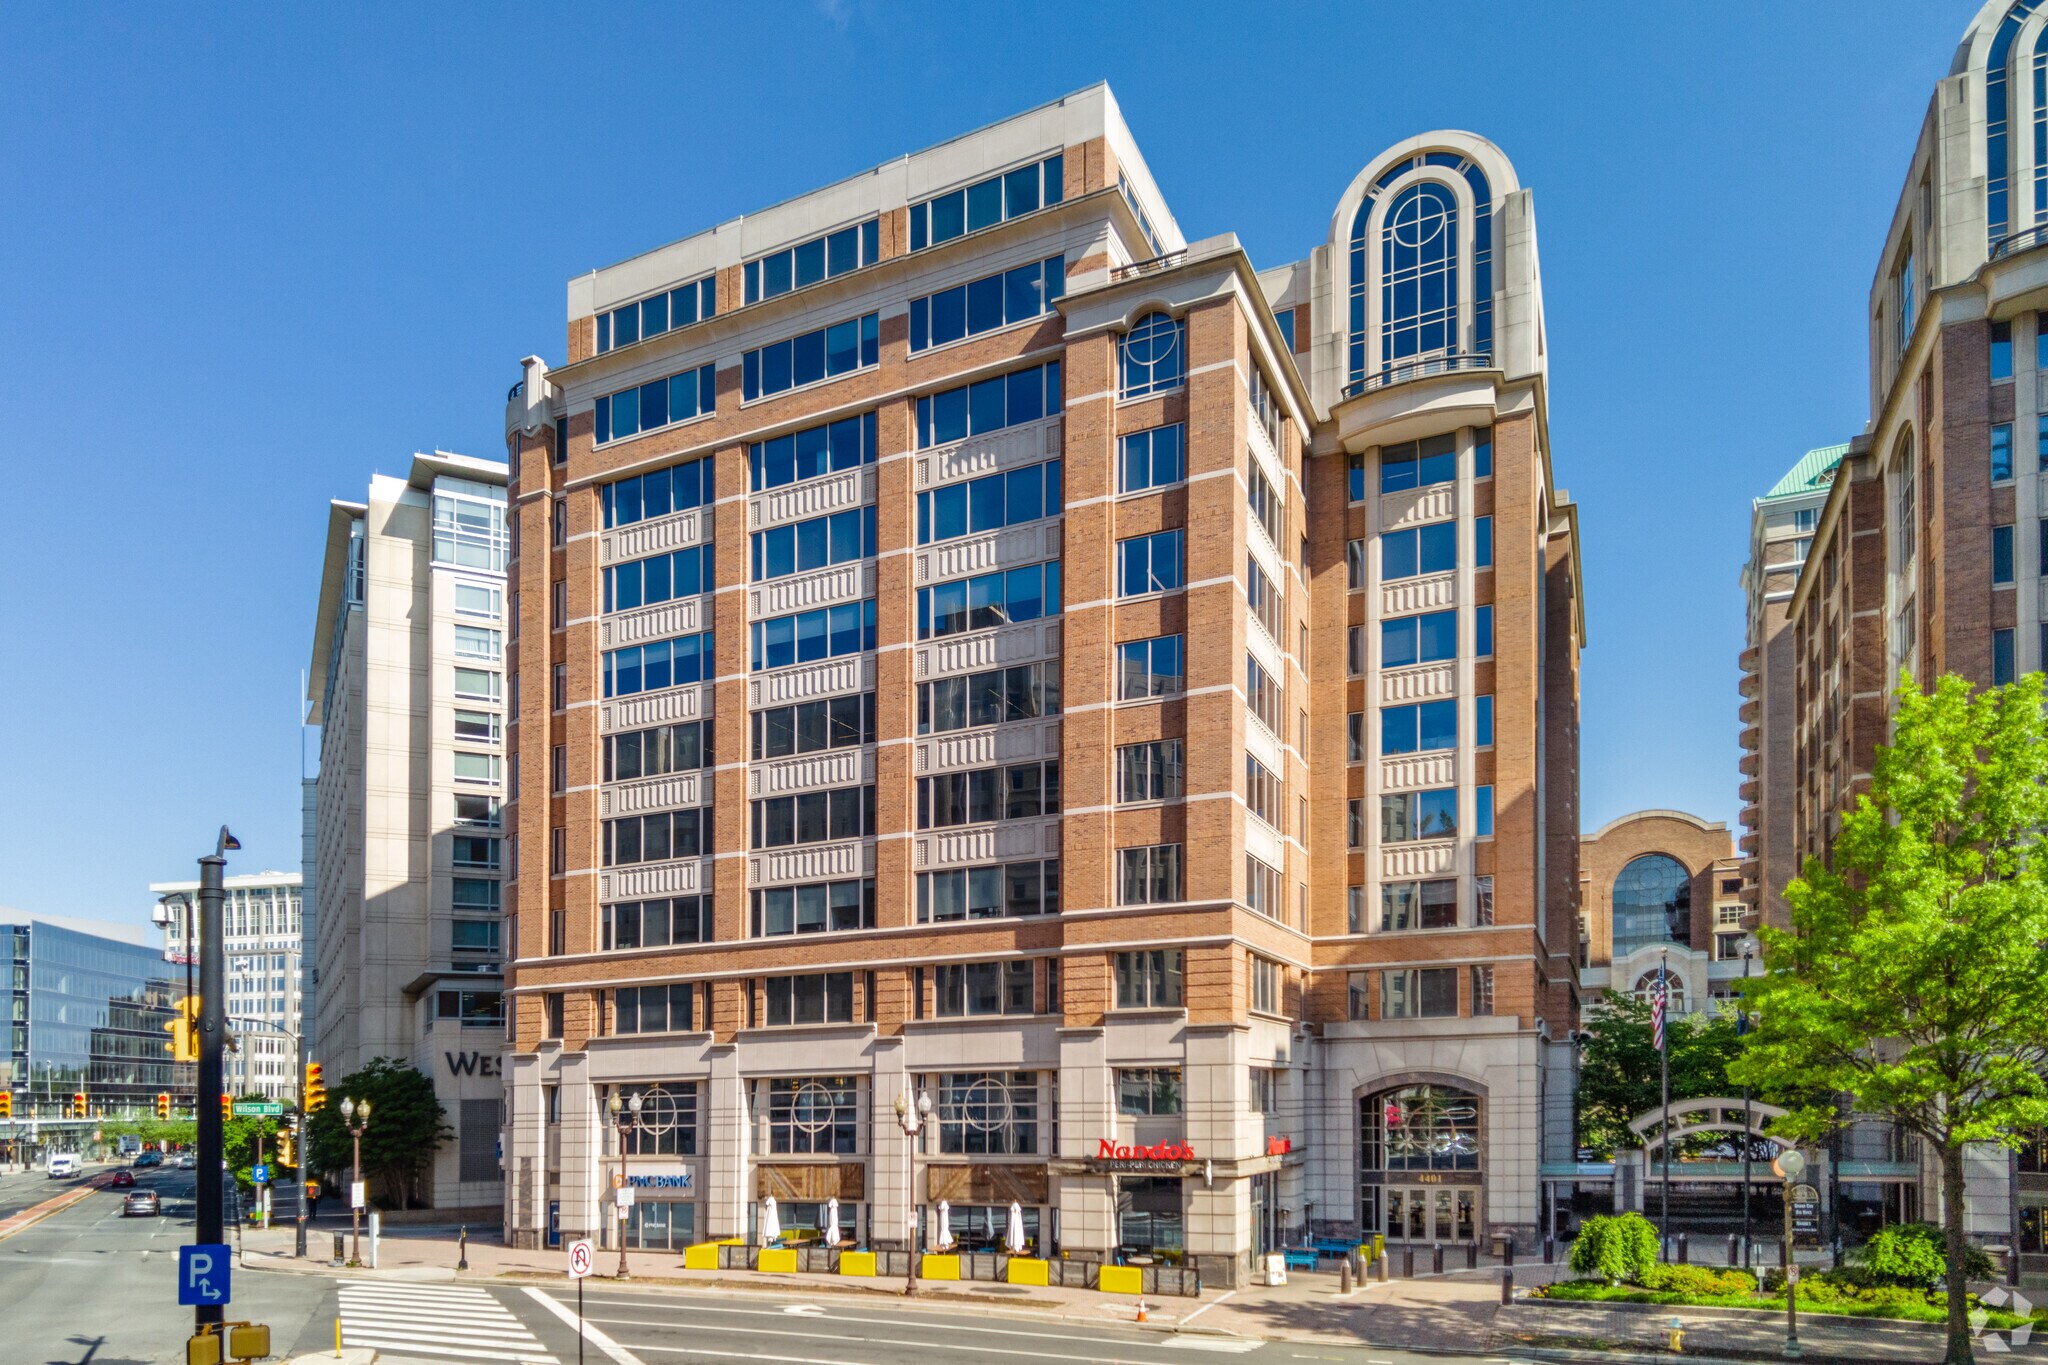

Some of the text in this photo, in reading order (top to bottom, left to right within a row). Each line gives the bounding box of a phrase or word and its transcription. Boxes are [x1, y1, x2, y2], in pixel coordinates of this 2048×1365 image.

[235, 1104, 280, 1113] Wilson Blvd
[1096, 1138, 1195, 1161] Nando's
[1109, 1160, 1183, 1169] PERI-PERI CHICKEN
[256, 1168, 263, 1178] P
[1418, 1175, 1442, 1183] 4401
[189, 1253, 213, 1288] P
